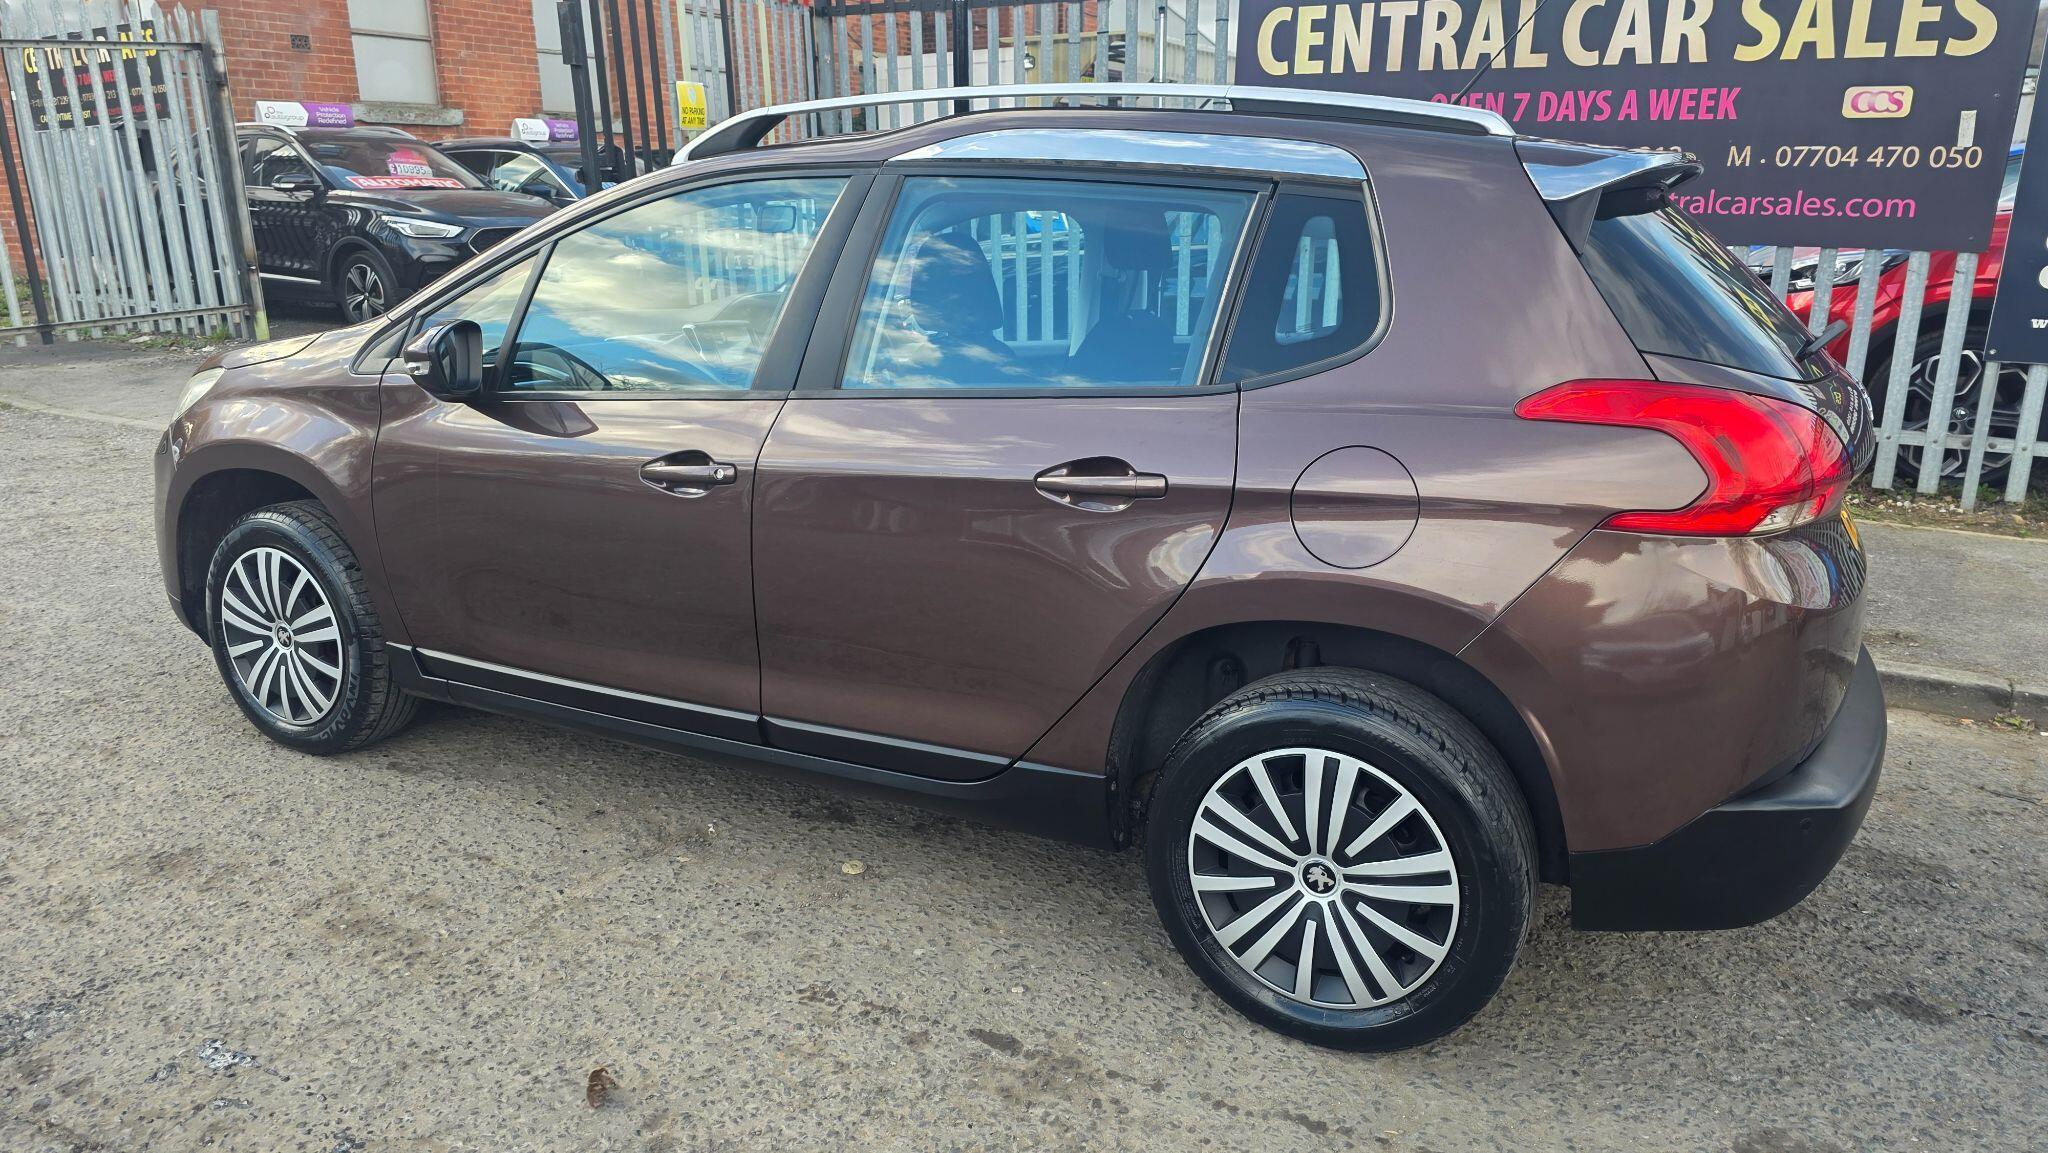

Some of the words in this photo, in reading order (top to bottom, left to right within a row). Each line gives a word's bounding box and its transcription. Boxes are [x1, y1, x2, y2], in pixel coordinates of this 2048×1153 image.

[1257, 0, 1548, 75] CENTRAL
[1562, 0, 1709, 67] CAR
[1733, 0, 1999, 61] SALES
[1513, 92, 1531, 122] 7
[1537, 90, 1612, 122] DAYS
[1618, 89, 1638, 121] A
[1650, 87, 1741, 121] WEEK
[1850, 91, 1905, 114] CCS
[315, 111, 346, 119] Protection
[690, 107, 705, 116] PARKING
[317, 117, 347, 125] Redefined
[1726, 145, 1751, 167] M
[1775, 145, 1858, 168] 07704
[1866, 145, 1920, 168] 470
[1929, 145, 1983, 168] 050
[358, 176, 456, 188] AUTOMATIC
